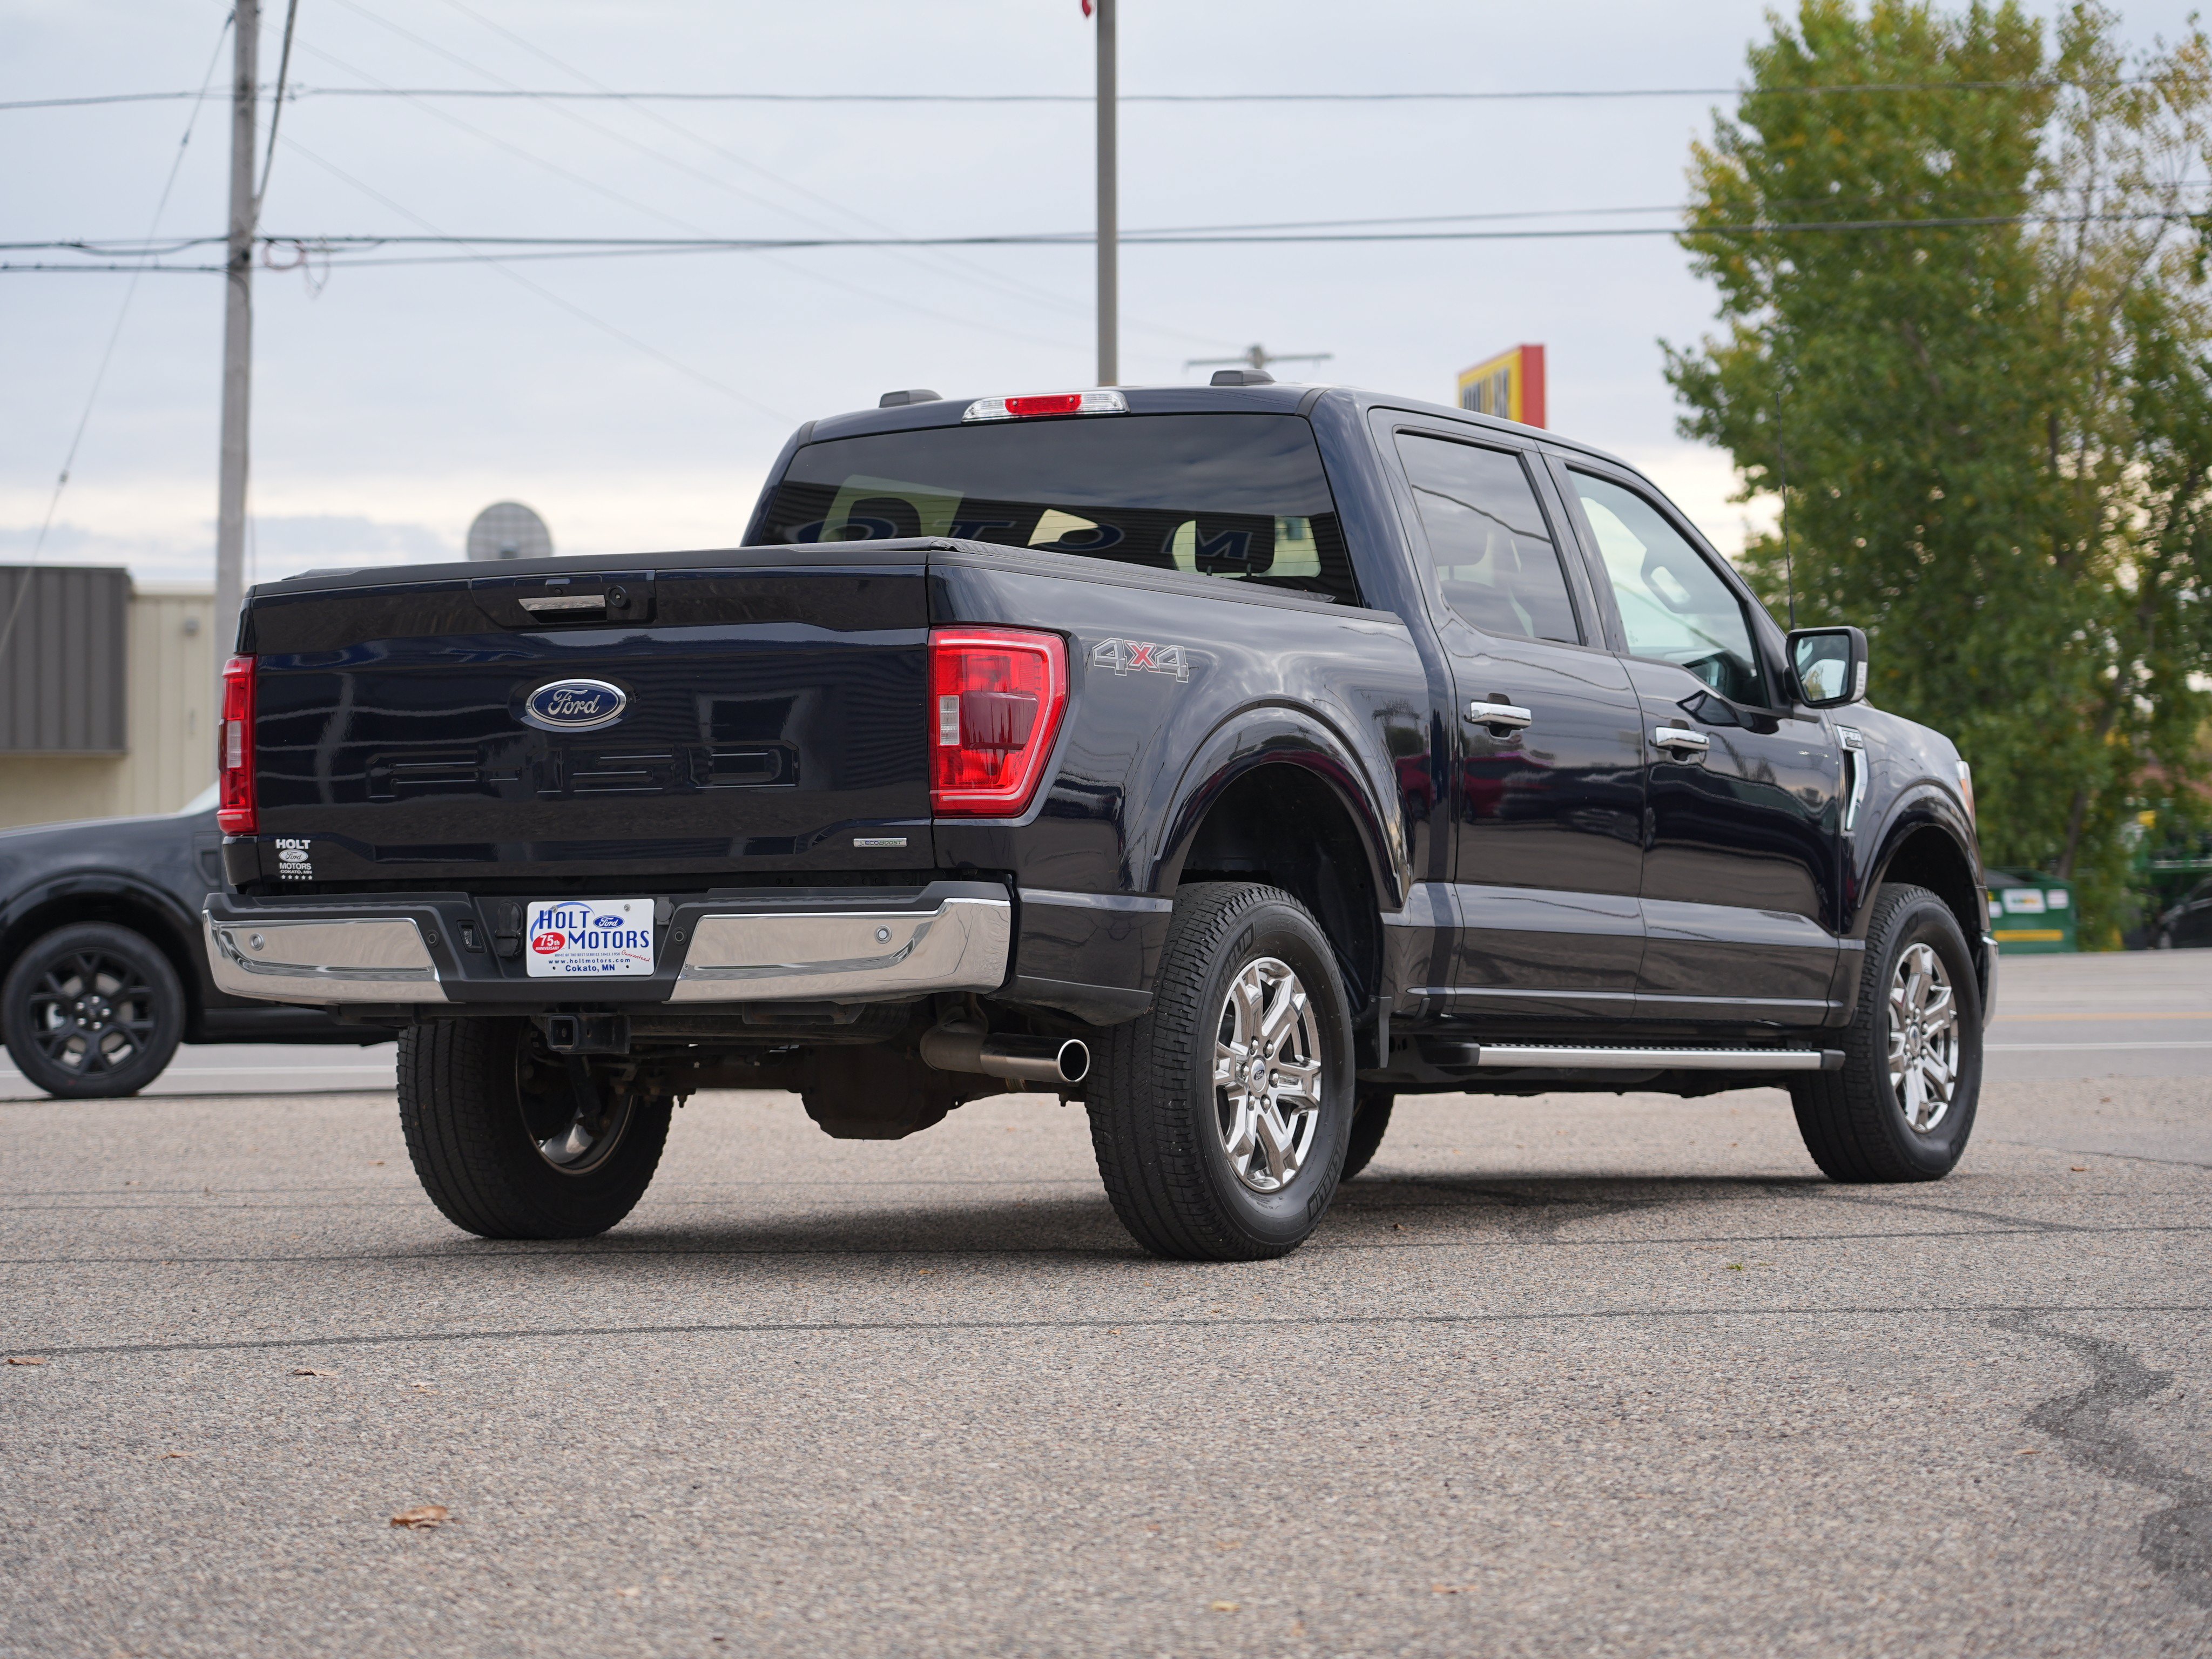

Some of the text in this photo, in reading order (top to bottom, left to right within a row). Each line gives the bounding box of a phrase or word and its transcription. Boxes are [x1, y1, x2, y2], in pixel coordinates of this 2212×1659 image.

[548, 689, 601, 715] Ford
[367, 739, 800, 799] F-150
[276, 839, 311, 849] HOLT
[286, 852, 302, 860] Ford
[539, 910, 590, 929] HOLT
[598, 917, 618, 927] Ford
[540, 935, 560, 946] 75th
[568, 930, 649, 949] MOTORS
[621, 949, 650, 962] Guaranteed
[565, 965, 599, 973] Cokato,
